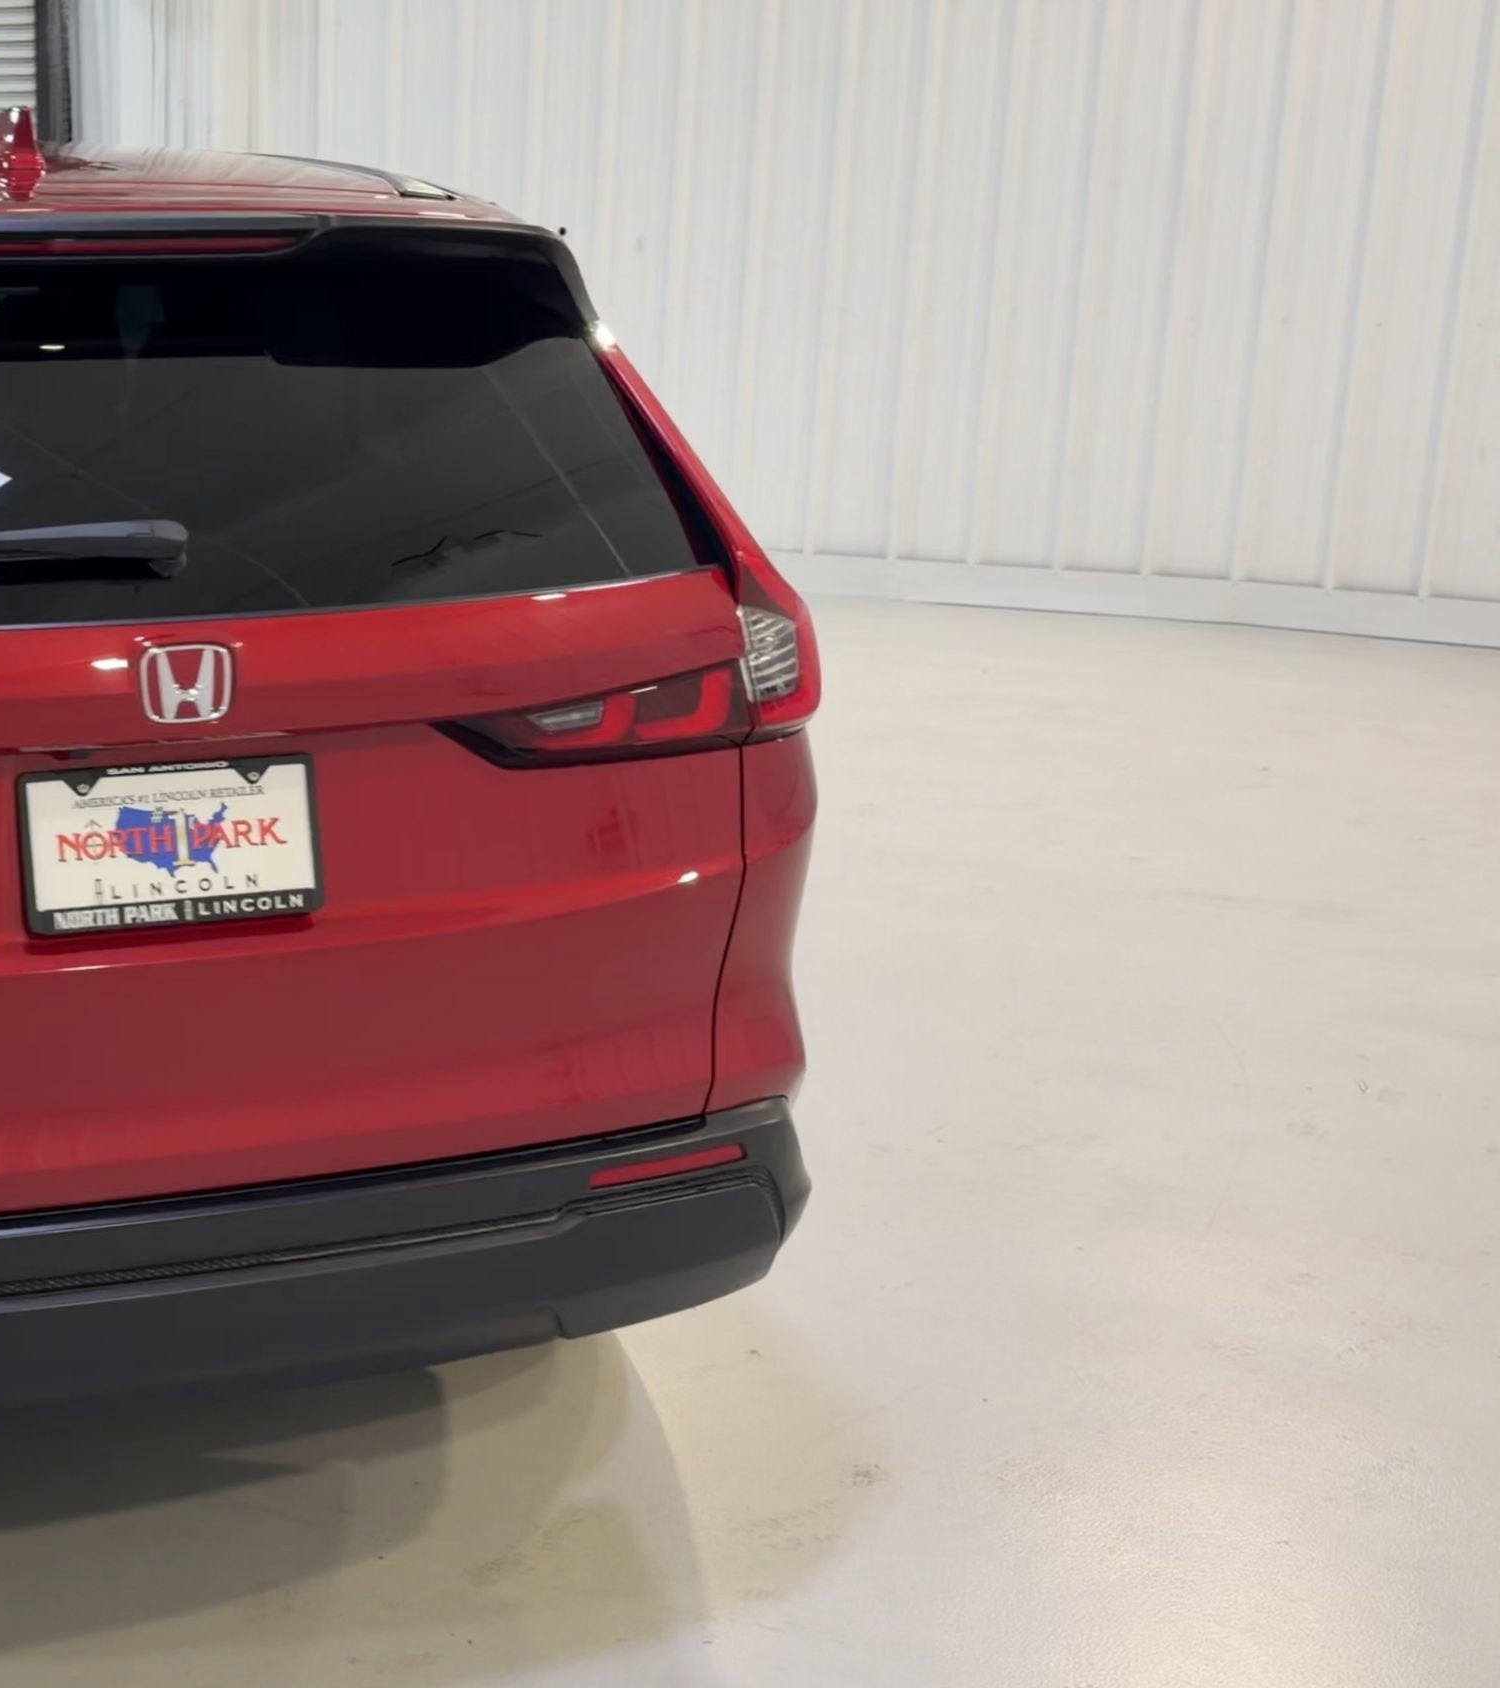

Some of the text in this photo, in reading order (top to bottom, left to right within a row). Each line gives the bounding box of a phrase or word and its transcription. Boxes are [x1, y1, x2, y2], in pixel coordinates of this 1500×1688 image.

[105, 760, 230, 776] SAN ANTONIO
[74, 795, 136, 809] AMERICA'S
[152, 788, 207, 803] LINCOLN
[209, 785, 265, 798] RETAILER
[57, 823, 174, 862] NORTH
[192, 817, 288, 850] PARK
[110, 873, 260, 900] LINCOLN
[53, 894, 304, 931] NORTH PARK LINCOLN
